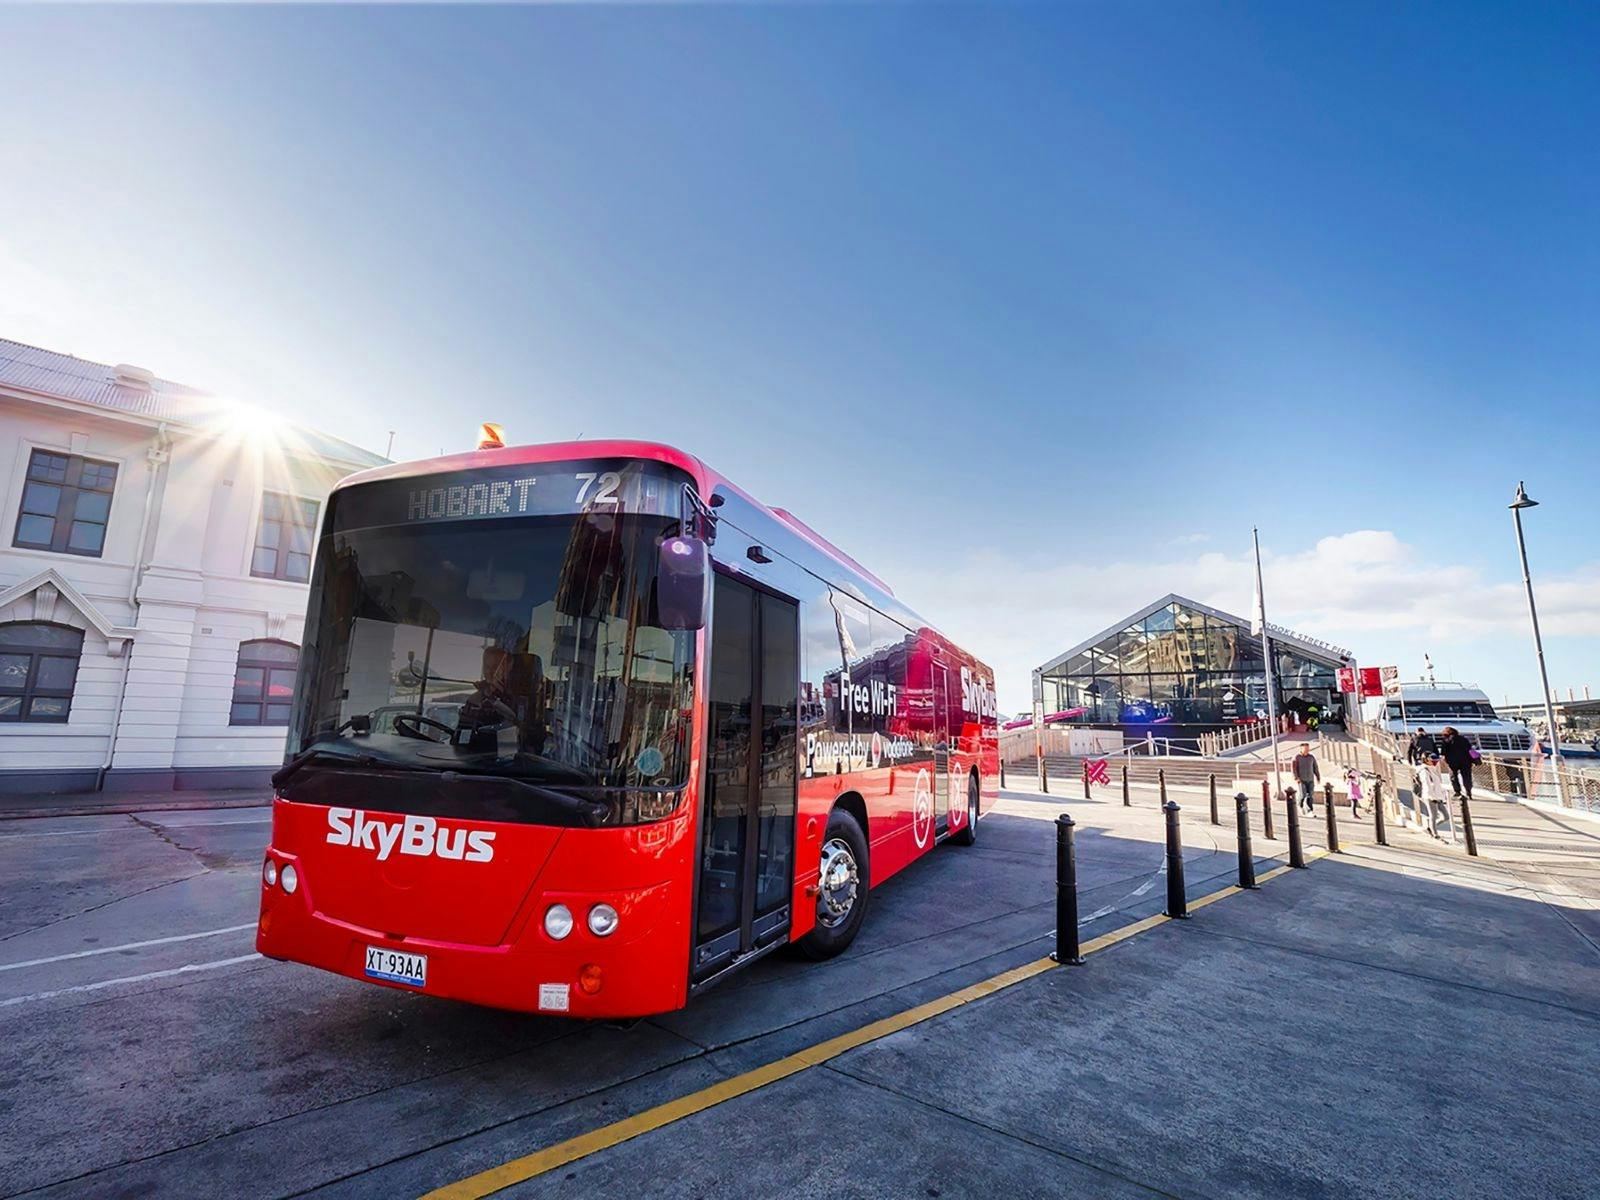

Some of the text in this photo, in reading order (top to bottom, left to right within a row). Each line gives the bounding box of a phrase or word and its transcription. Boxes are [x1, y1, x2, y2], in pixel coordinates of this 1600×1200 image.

[408, 478, 536, 520] HOBART
[575, 472, 622, 504] 72
[1298, 633, 1330, 648] STREET
[1332, 645, 1353, 658] PIER
[841, 671, 897, 717] Free Wi-Fi
[806, 733, 857, 767] Powered
[857, 734, 869, 759] by
[326, 807, 496, 863] SkyBus
